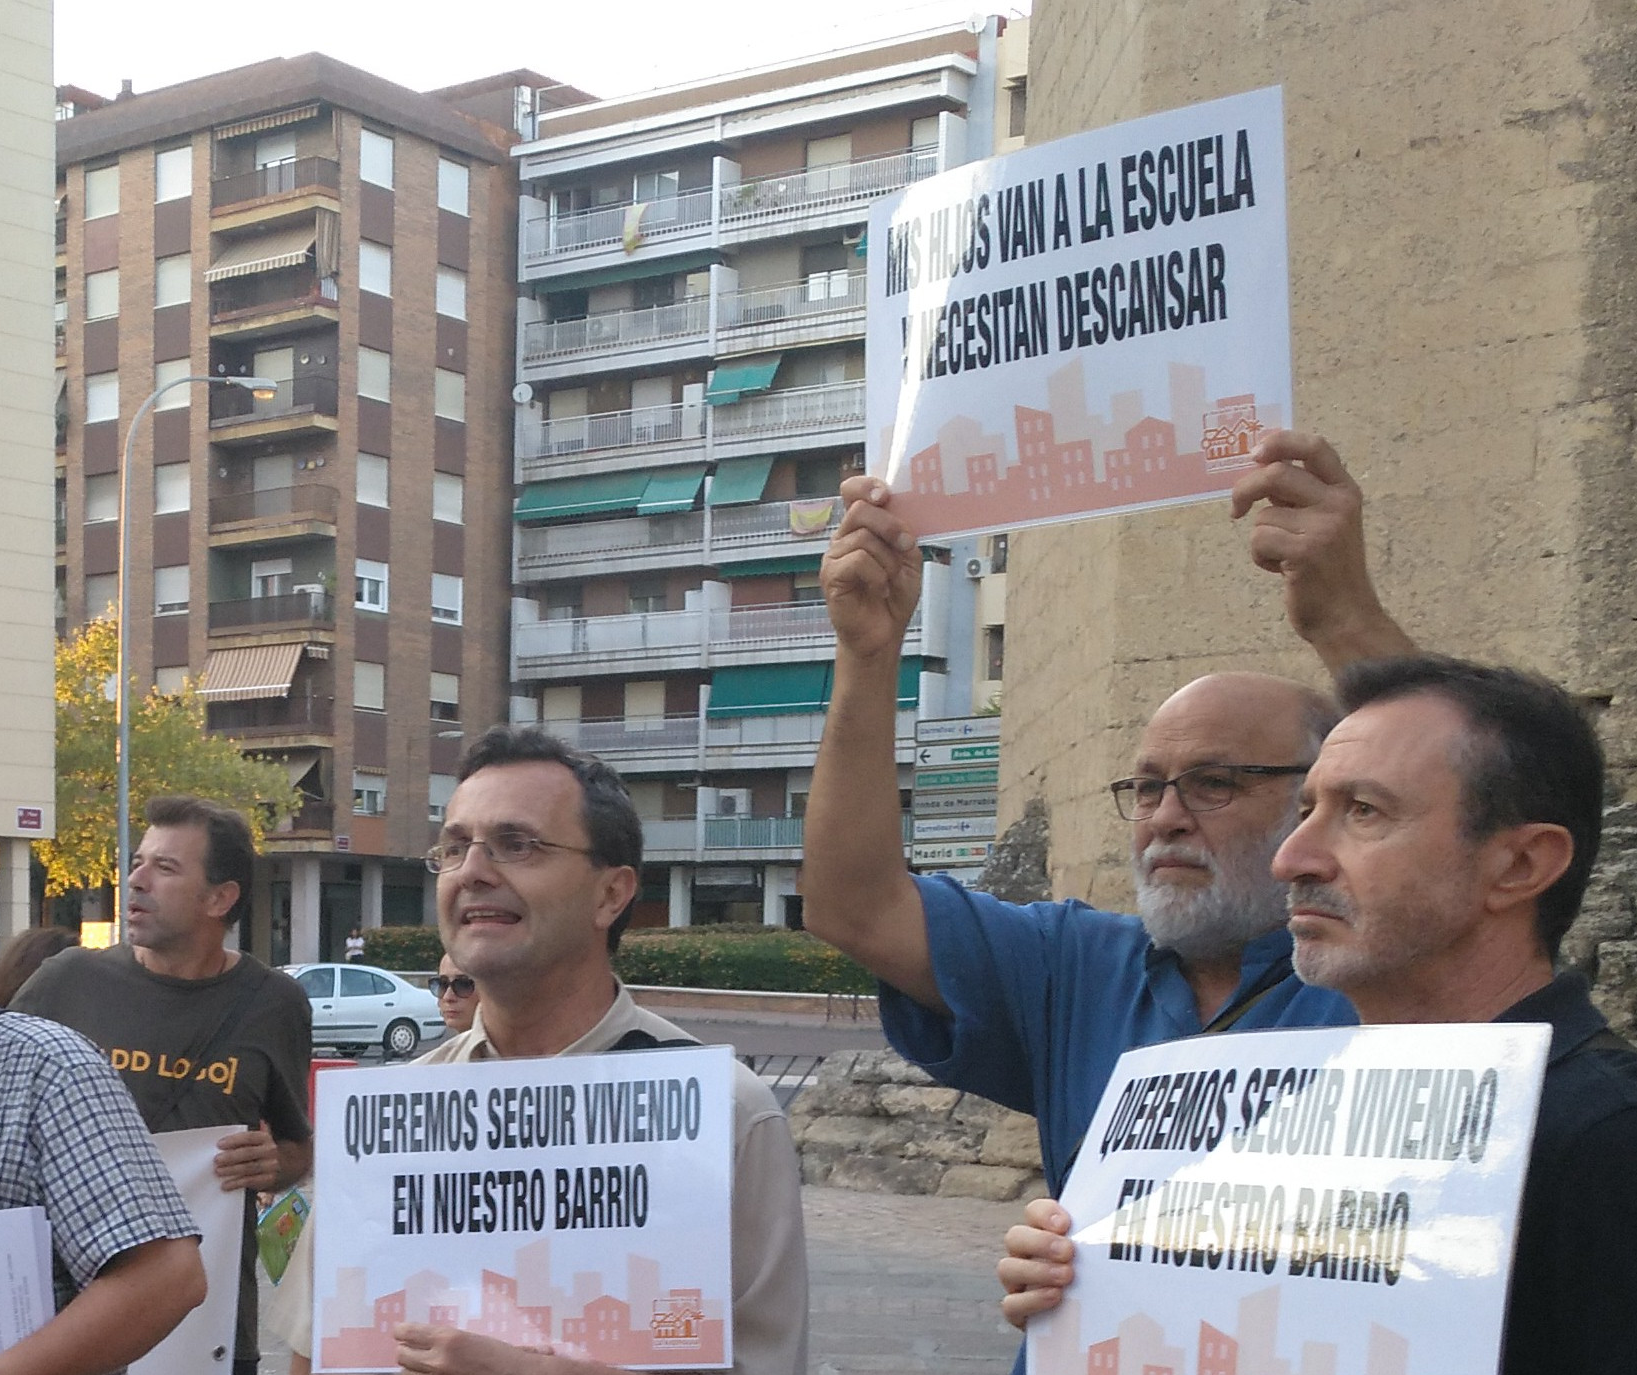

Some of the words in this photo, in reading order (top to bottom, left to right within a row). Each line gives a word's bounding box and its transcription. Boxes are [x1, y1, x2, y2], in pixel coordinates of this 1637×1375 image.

[886, 216, 921, 297] MIS
[929, 199, 990, 283] HIJOS
[998, 178, 1045, 263] VAN
[1053, 172, 1072, 250] A
[1078, 162, 1114, 245] LA
[1121, 128, 1256, 234] ESCUELA
[920, 281, 1049, 382] NECESITAN
[1055, 243, 1227, 352] DESCANSAR
[915, 849, 952, 858] Madrid
[344, 1088, 479, 1163] QUEREMOS
[486, 1084, 575, 1150] SEGUIR
[583, 1077, 701, 1144] VIVIENDO
[1100, 1069, 1237, 1163] QUEREMOS
[1231, 1068, 1344, 1156] SEGUIR
[1344, 1068, 1499, 1164] VIVIENDO
[392, 1174, 424, 1236] EN
[433, 1168, 545, 1234] NUESTRO
[554, 1164, 650, 1230] BARRIO
[1109, 1178, 1155, 1263] EN
[1152, 1181, 1286, 1275] NUESTRO
[1288, 1188, 1411, 1287] BARRIO
